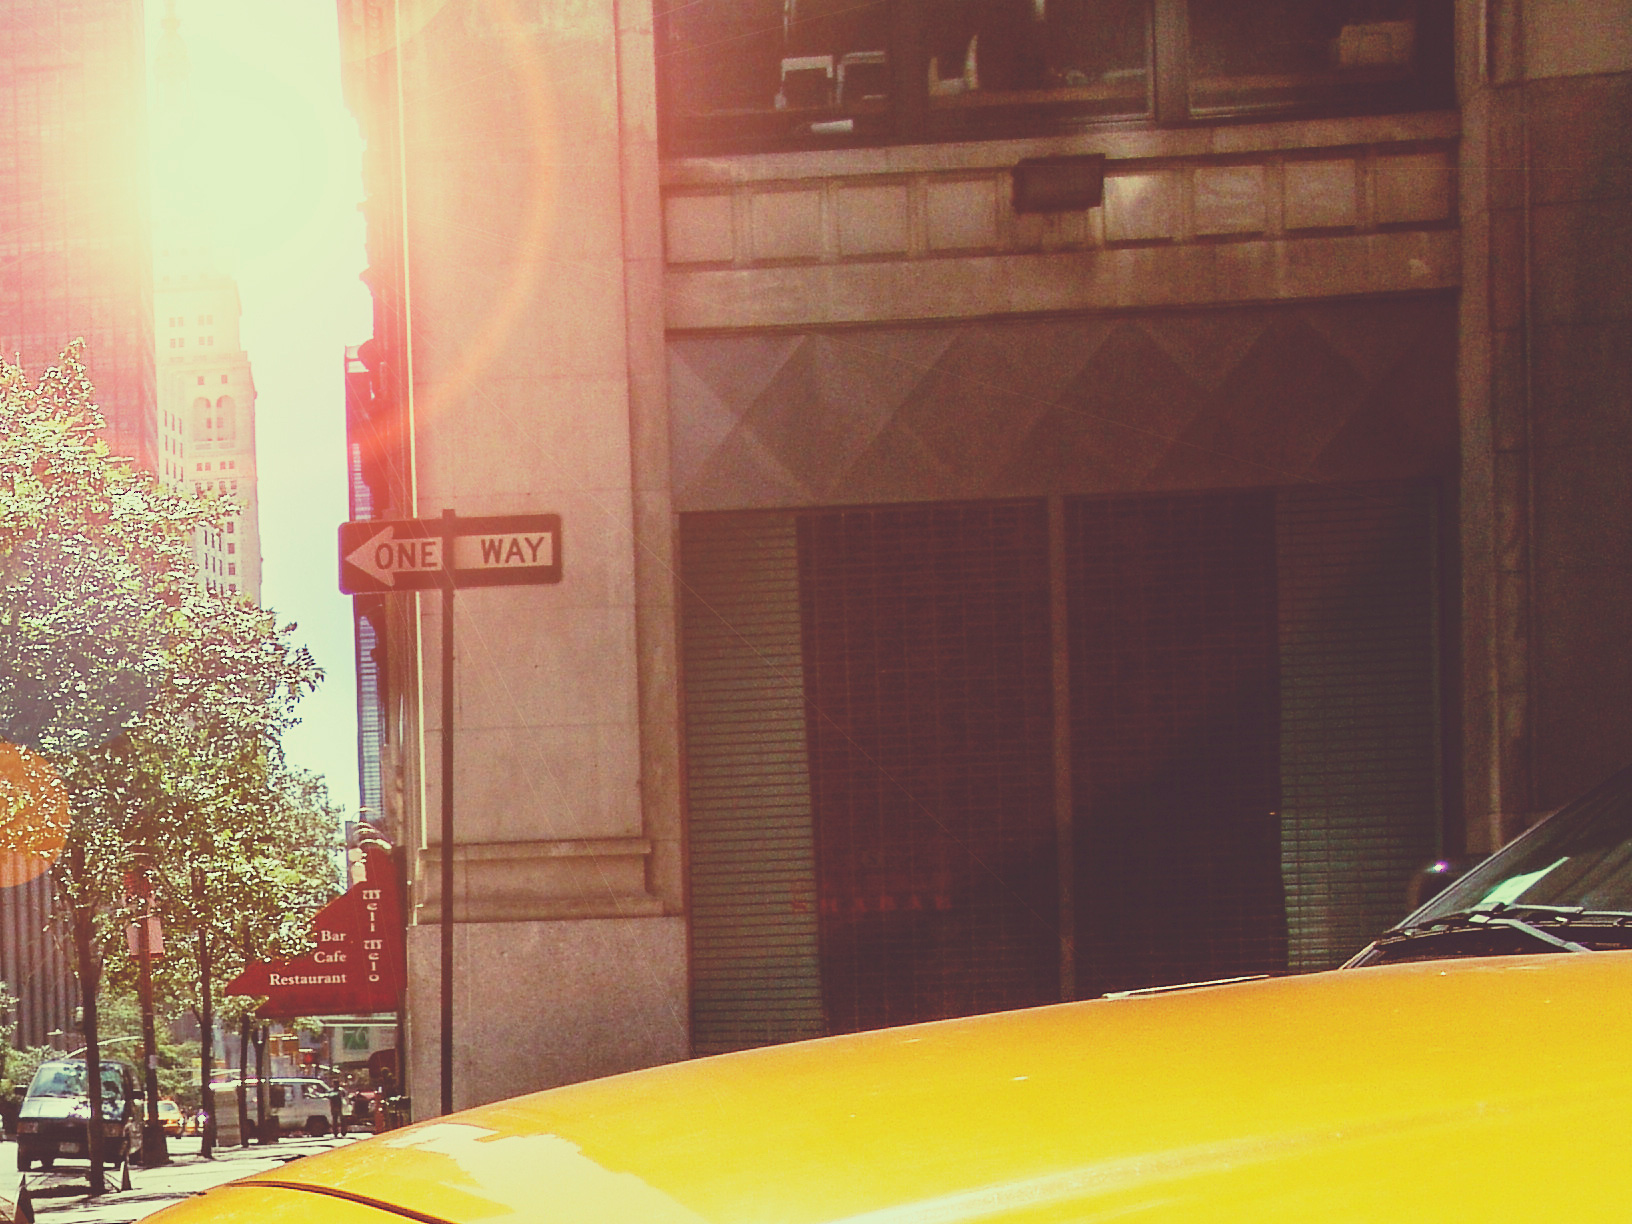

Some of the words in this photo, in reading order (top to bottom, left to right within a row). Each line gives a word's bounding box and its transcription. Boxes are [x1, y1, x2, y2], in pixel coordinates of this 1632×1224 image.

[374, 541, 438, 570] ONE
[480, 536, 545, 565] WAY
[321, 930, 347, 942] Bar
[314, 950, 347, 963] Cafe
[269, 973, 347, 986] Restaurant
